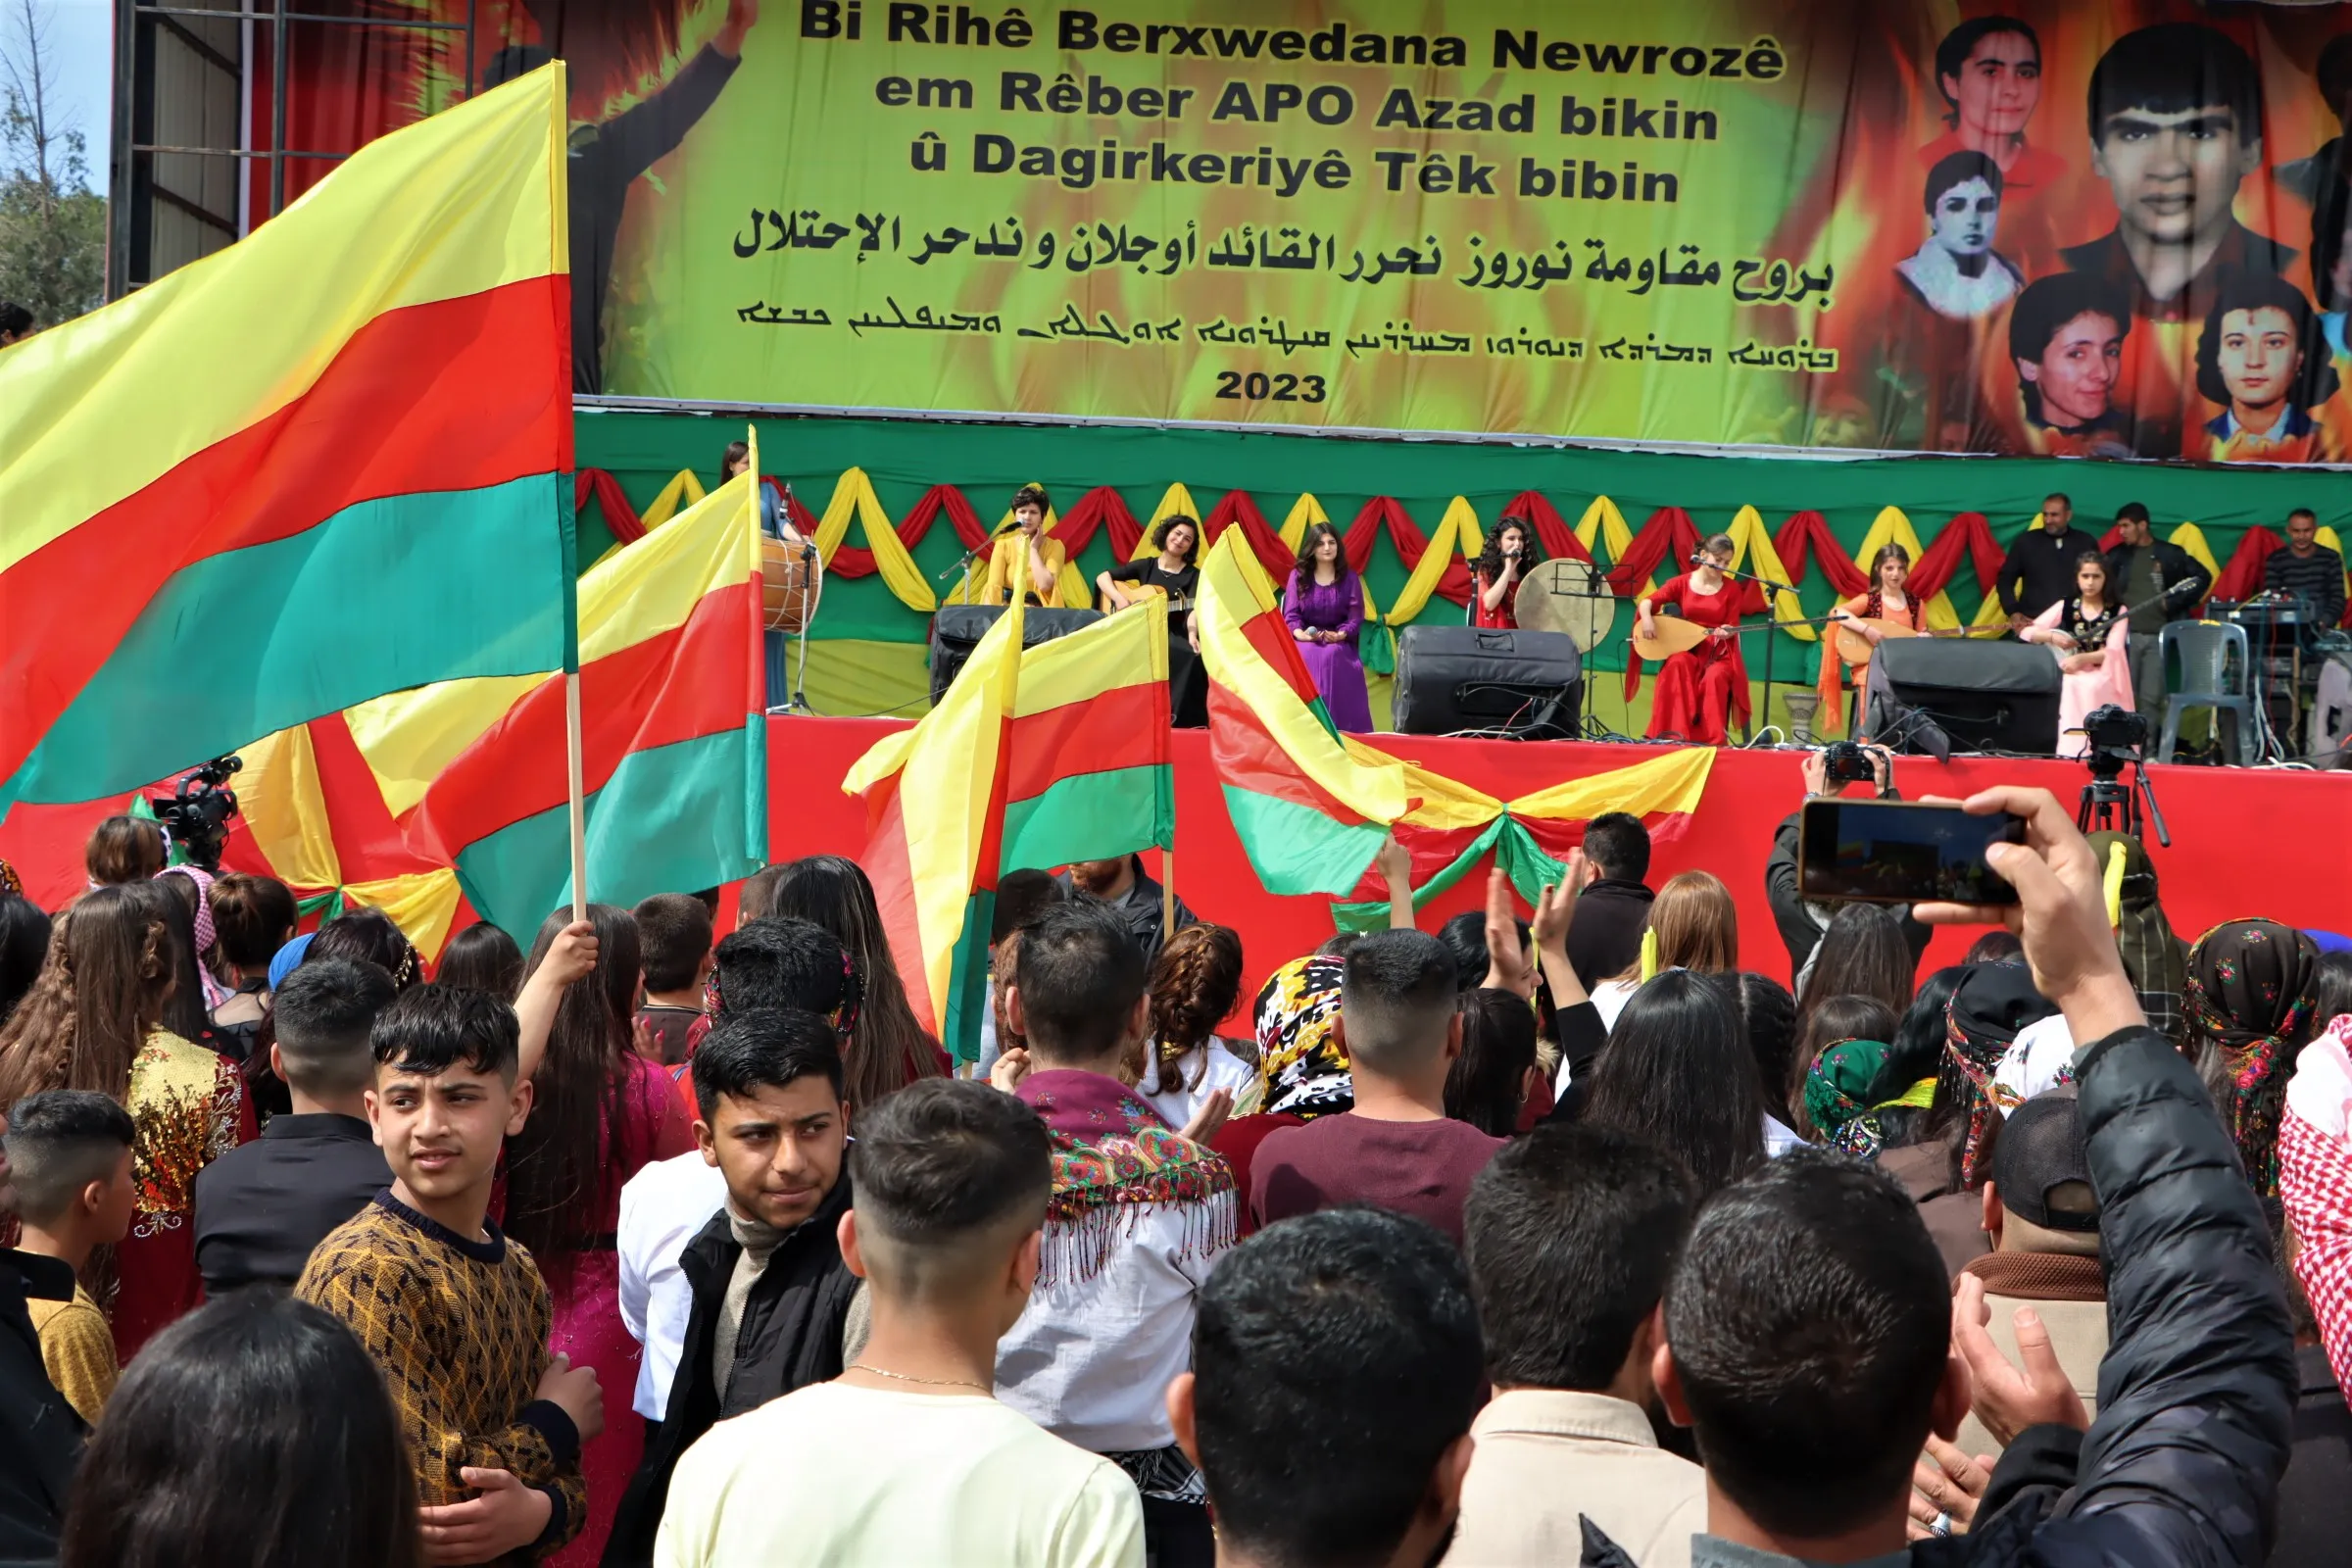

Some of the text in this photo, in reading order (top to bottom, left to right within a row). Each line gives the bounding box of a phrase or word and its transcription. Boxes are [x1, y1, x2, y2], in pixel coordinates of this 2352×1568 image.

[800, 0, 1785, 80] Bi Rihê Berxwedana Newrozê
[875, 71, 1718, 140] em Rêber APO Azad bikin
[910, 131, 1678, 203] û Dagirkeriyê Têk bibin
[733, 208, 901, 265] الإحتلال
[1065, 220, 1196, 275] أوجلان
[1208, 226, 1335, 270] القائد
[1339, 234, 1442, 285] نحرر
[1458, 236, 1572, 291] نوروز
[1584, 238, 1721, 296] مقاومة
[1733, 260, 1834, 308] بروح
[1215, 370, 1326, 404] 2023
